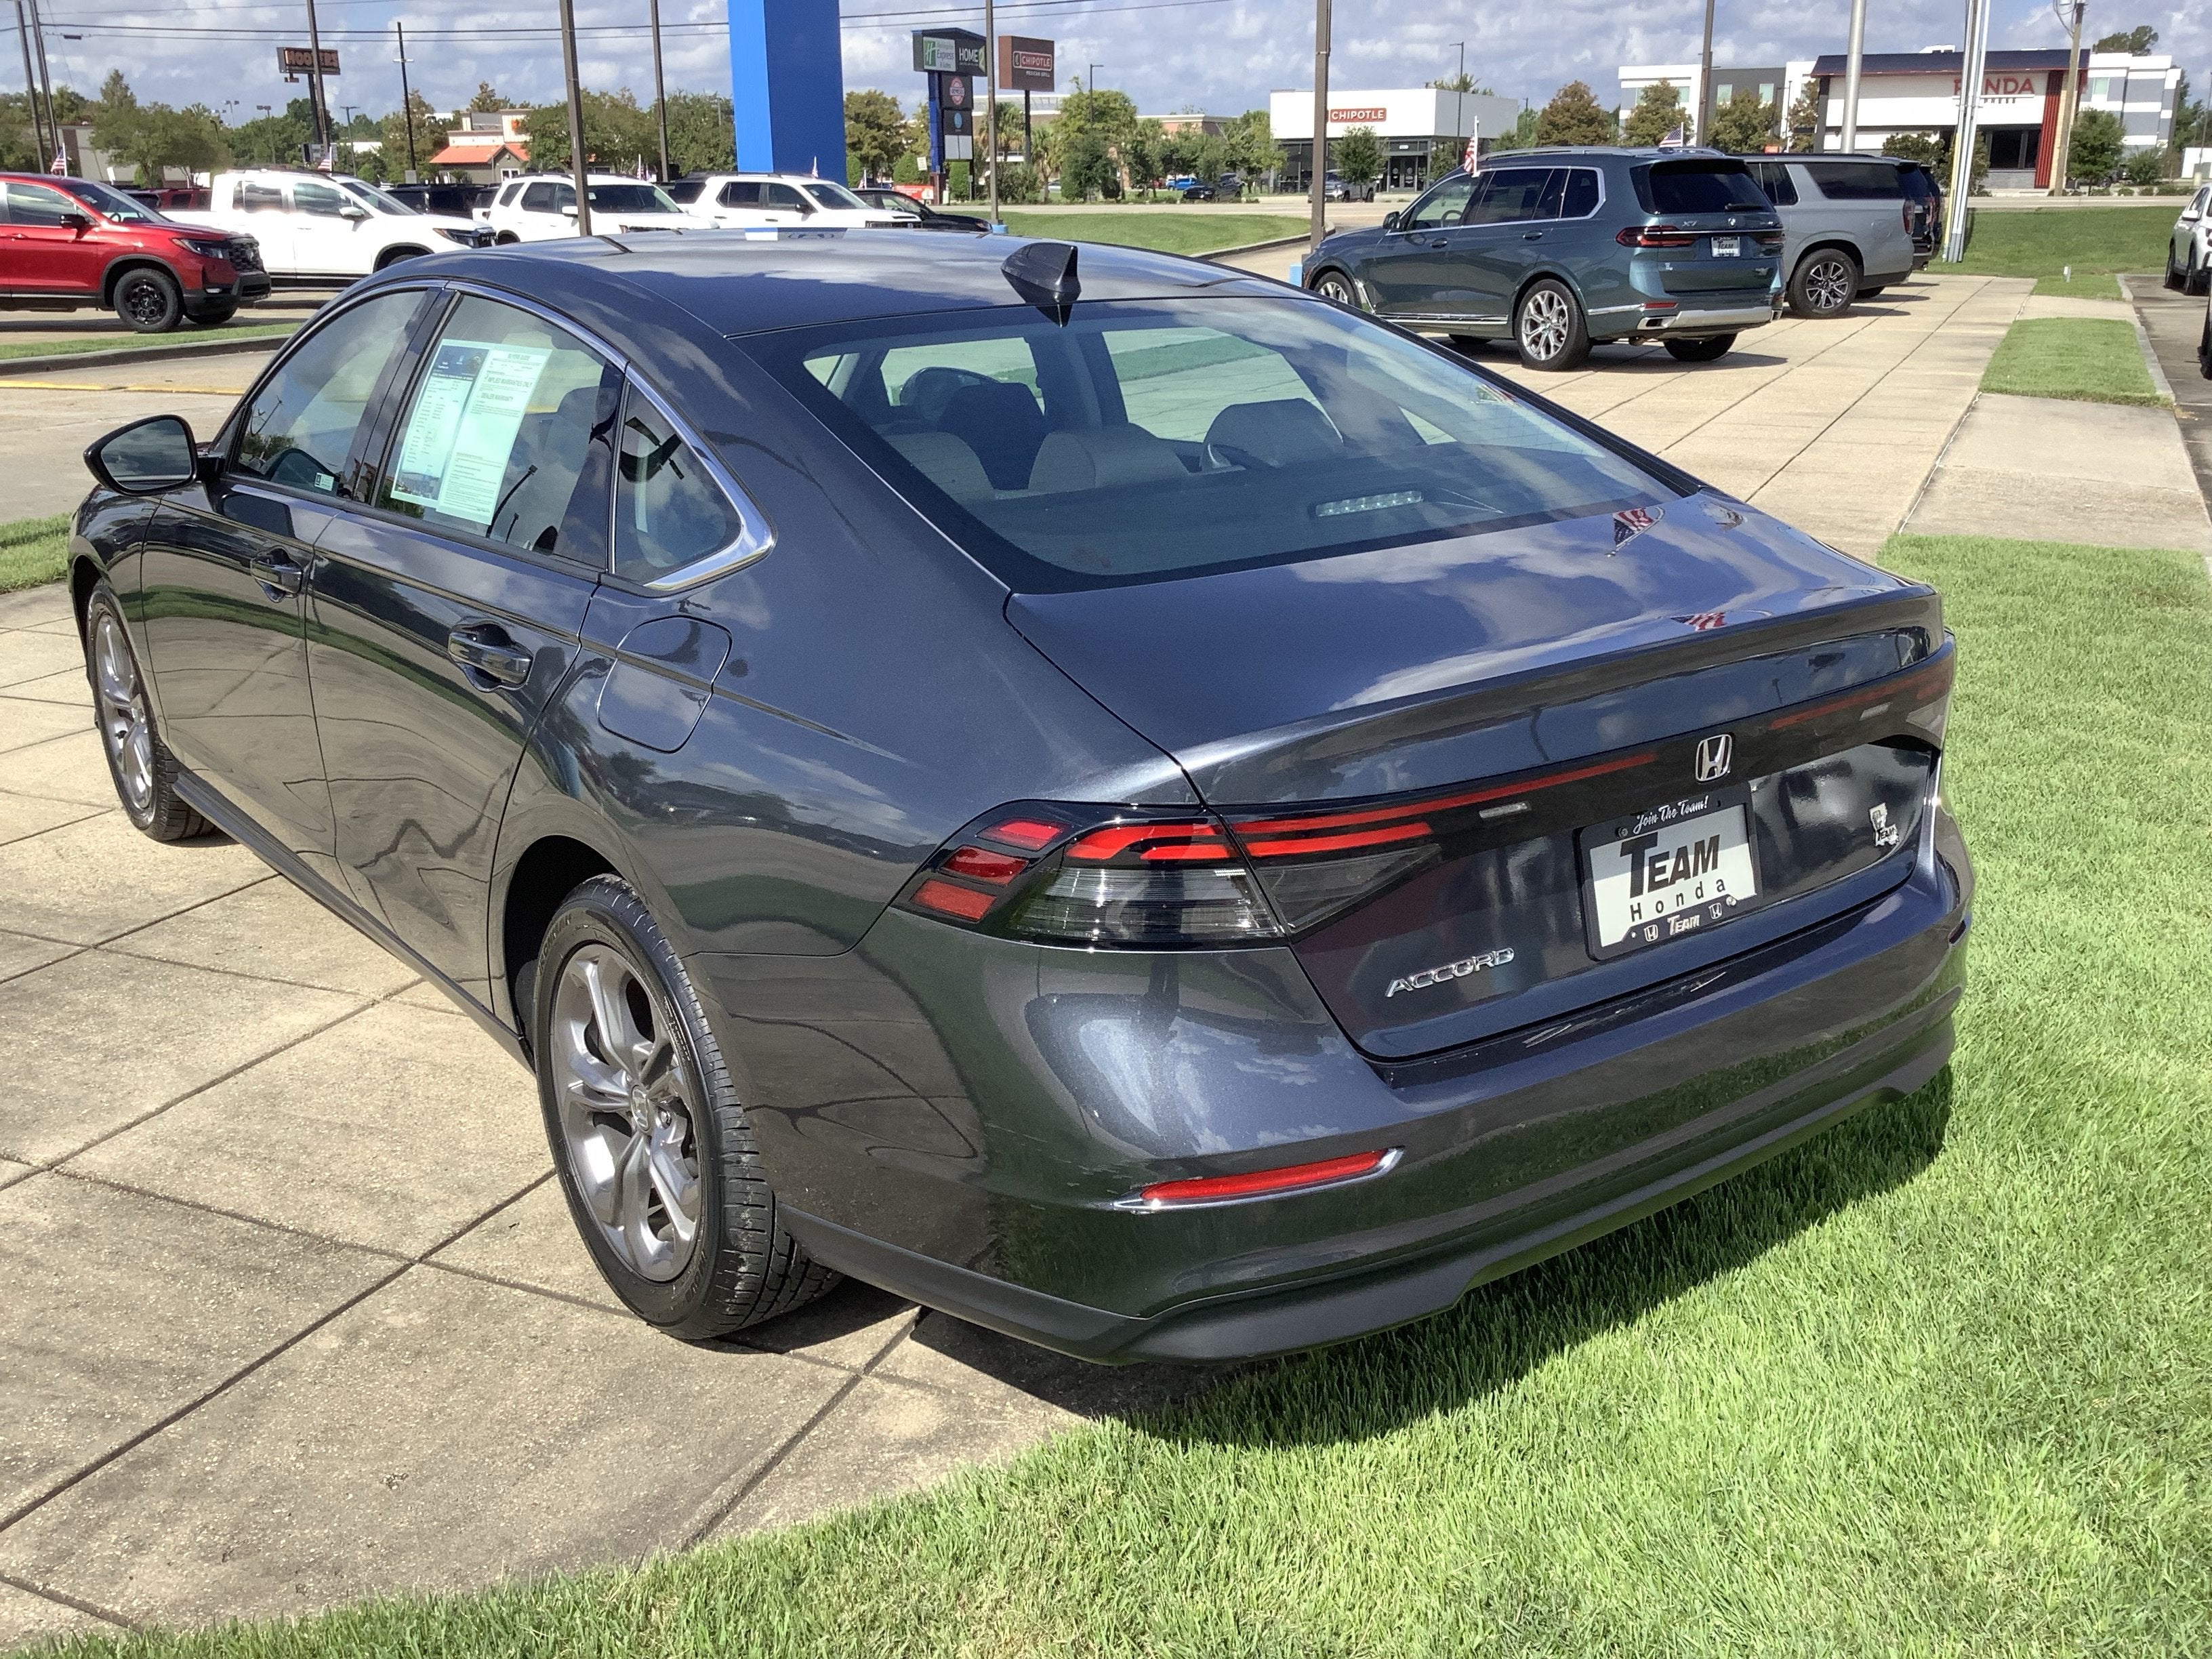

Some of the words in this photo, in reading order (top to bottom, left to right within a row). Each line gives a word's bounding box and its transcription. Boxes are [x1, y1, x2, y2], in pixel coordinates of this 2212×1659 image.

[285, 49, 338, 66] HOOERS
[937, 49, 955, 61] Express
[959, 47, 979, 62] HOME
[1021, 55, 1050, 67] CHIPOTLE
[1953, 77, 2034, 96] PNDA
[1331, 110, 1384, 121] CHIPOTLE
[1633, 813, 1658, 834] Join
[1658, 804, 1678, 821] The
[1677, 795, 1709, 815] Team!
[1620, 832, 1720, 899] TEAM
[1630, 878, 1725, 922] Honda
[1667, 914, 1700, 936] TEAM
[1385, 947, 1515, 998] ACCORD
